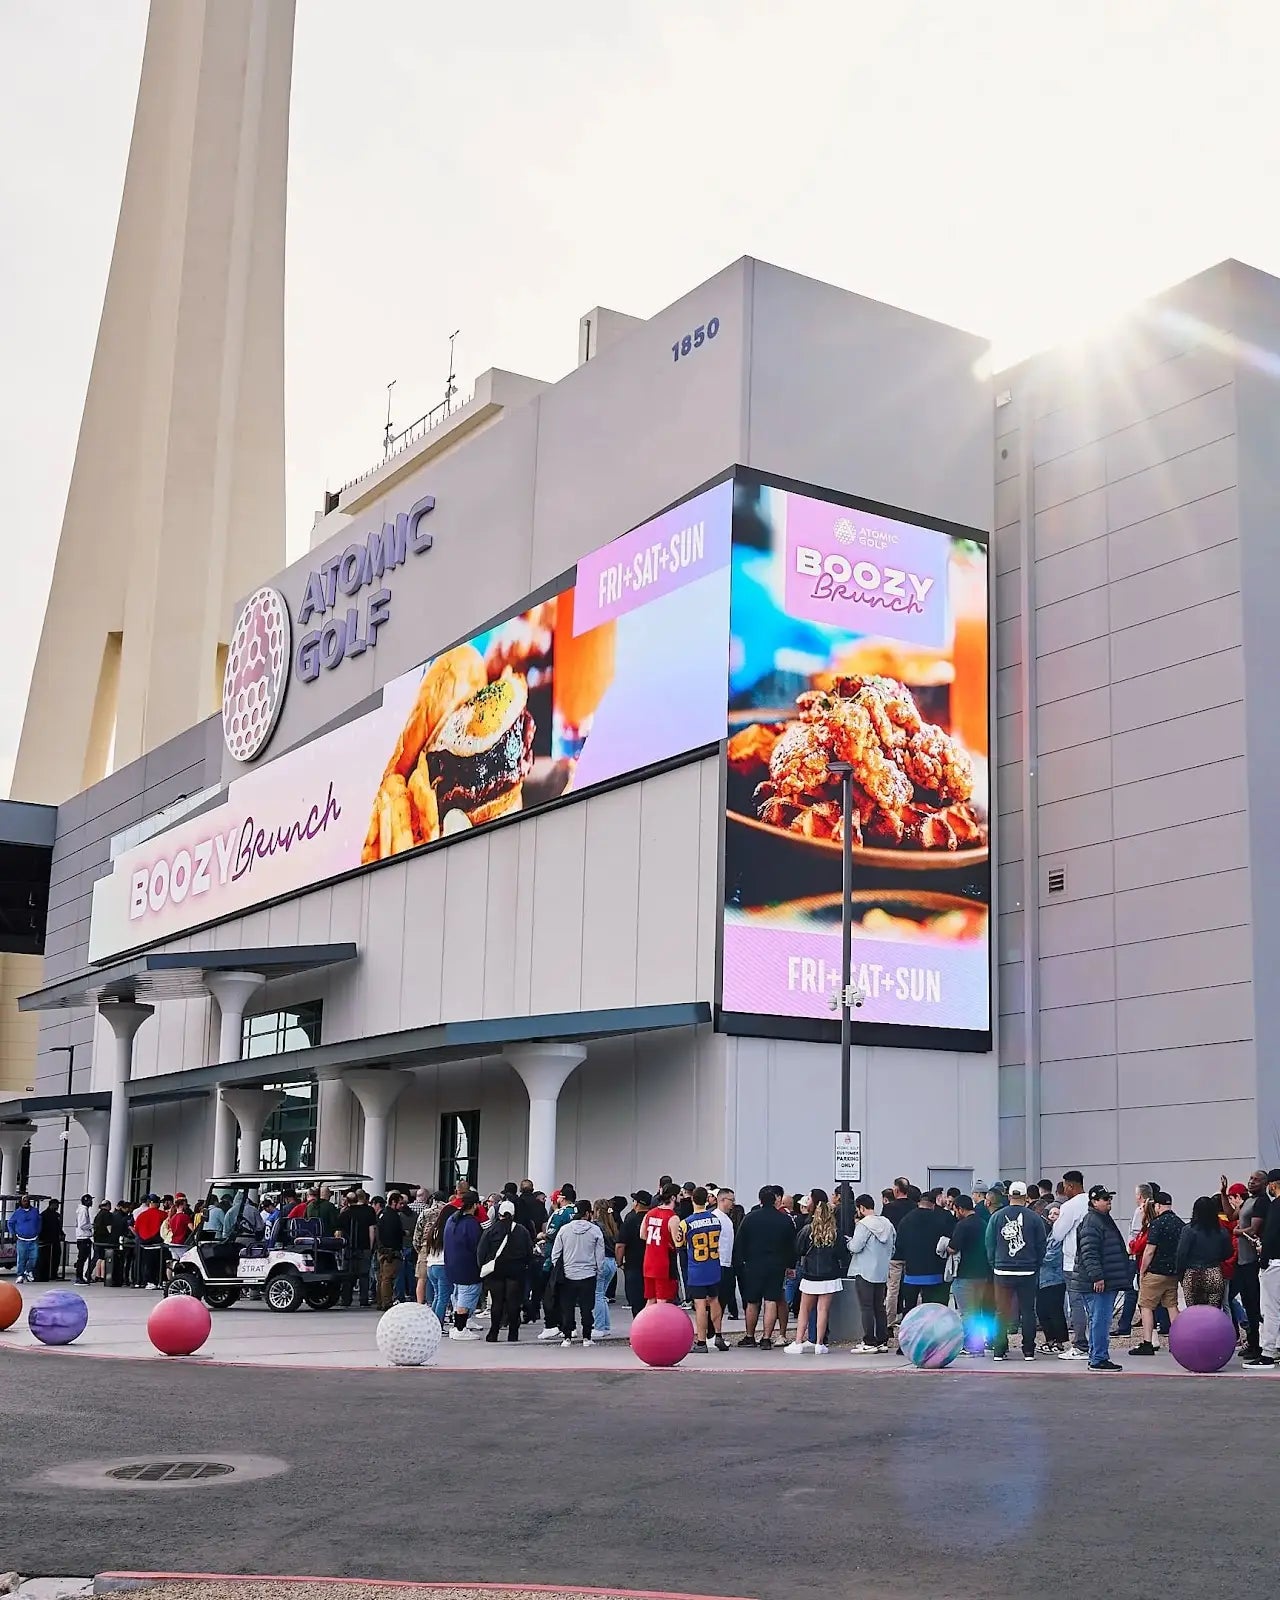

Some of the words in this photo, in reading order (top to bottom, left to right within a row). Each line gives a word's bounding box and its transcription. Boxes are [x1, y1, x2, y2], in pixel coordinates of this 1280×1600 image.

[671, 317, 720, 362] 1850
[858, 527, 901, 545] ATOMIC
[858, 536, 888, 550] GOLF
[297, 495, 436, 625] ATOMIC
[796, 545, 935, 602] BOOZY
[811, 572, 923, 614] Brunch
[296, 588, 392, 684] GOLF
[129, 826, 240, 921] BOOZY
[231, 781, 342, 882] Brunch
[647, 1225, 662, 1246] 14
[691, 1230, 720, 1262] 85
